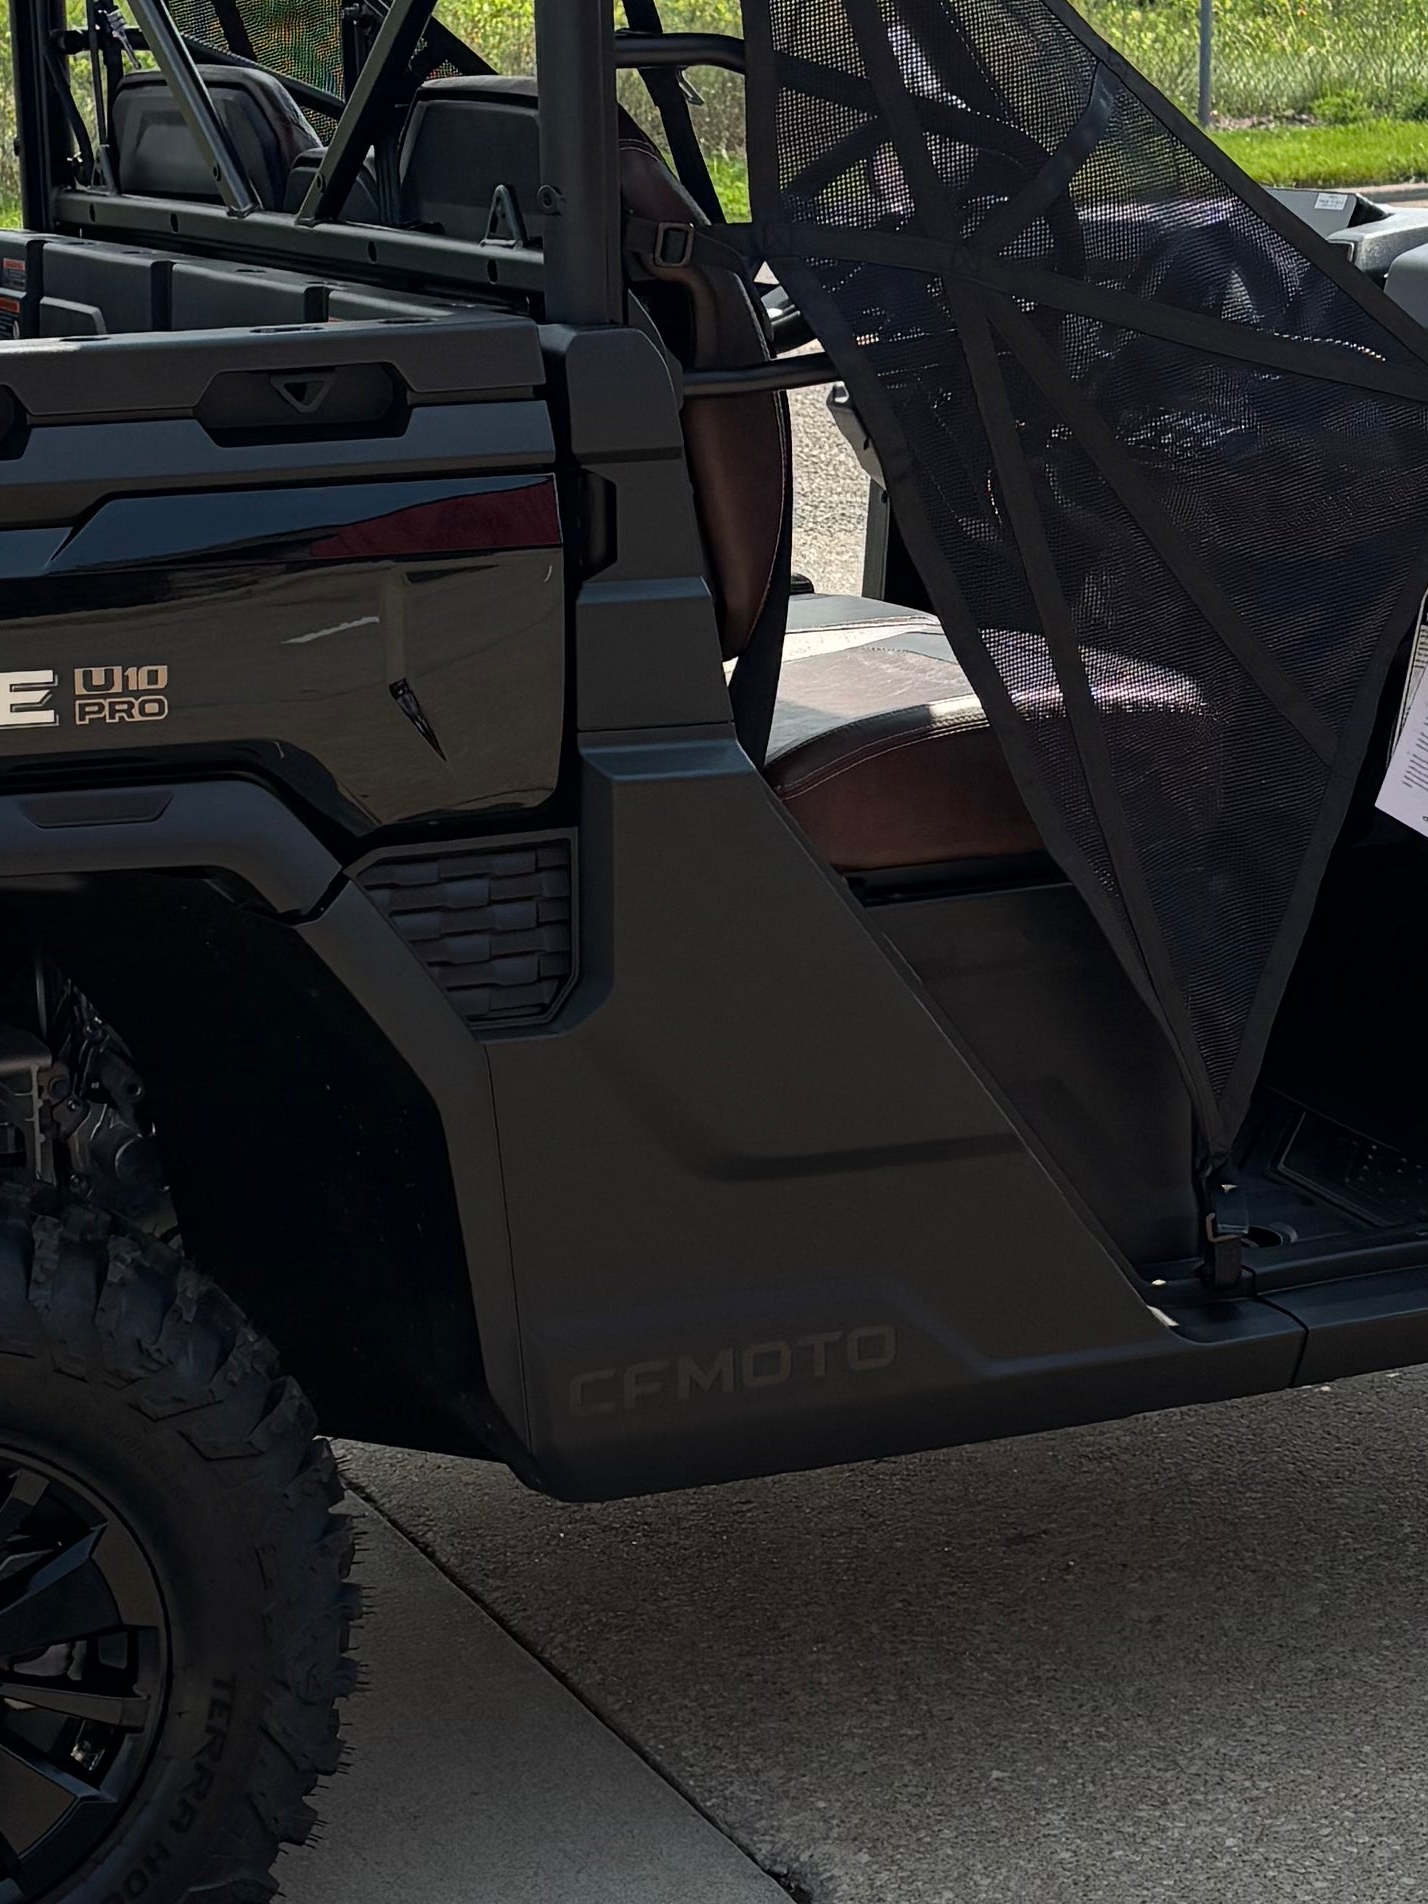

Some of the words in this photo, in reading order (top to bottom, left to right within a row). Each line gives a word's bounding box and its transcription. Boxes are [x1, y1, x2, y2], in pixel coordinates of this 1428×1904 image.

[74, 664, 168, 696] U10
[75, 696, 169, 725] PRO
[569, 1323, 898, 1418] CFMOTO
[169, 1671, 237, 1834] TERRA
